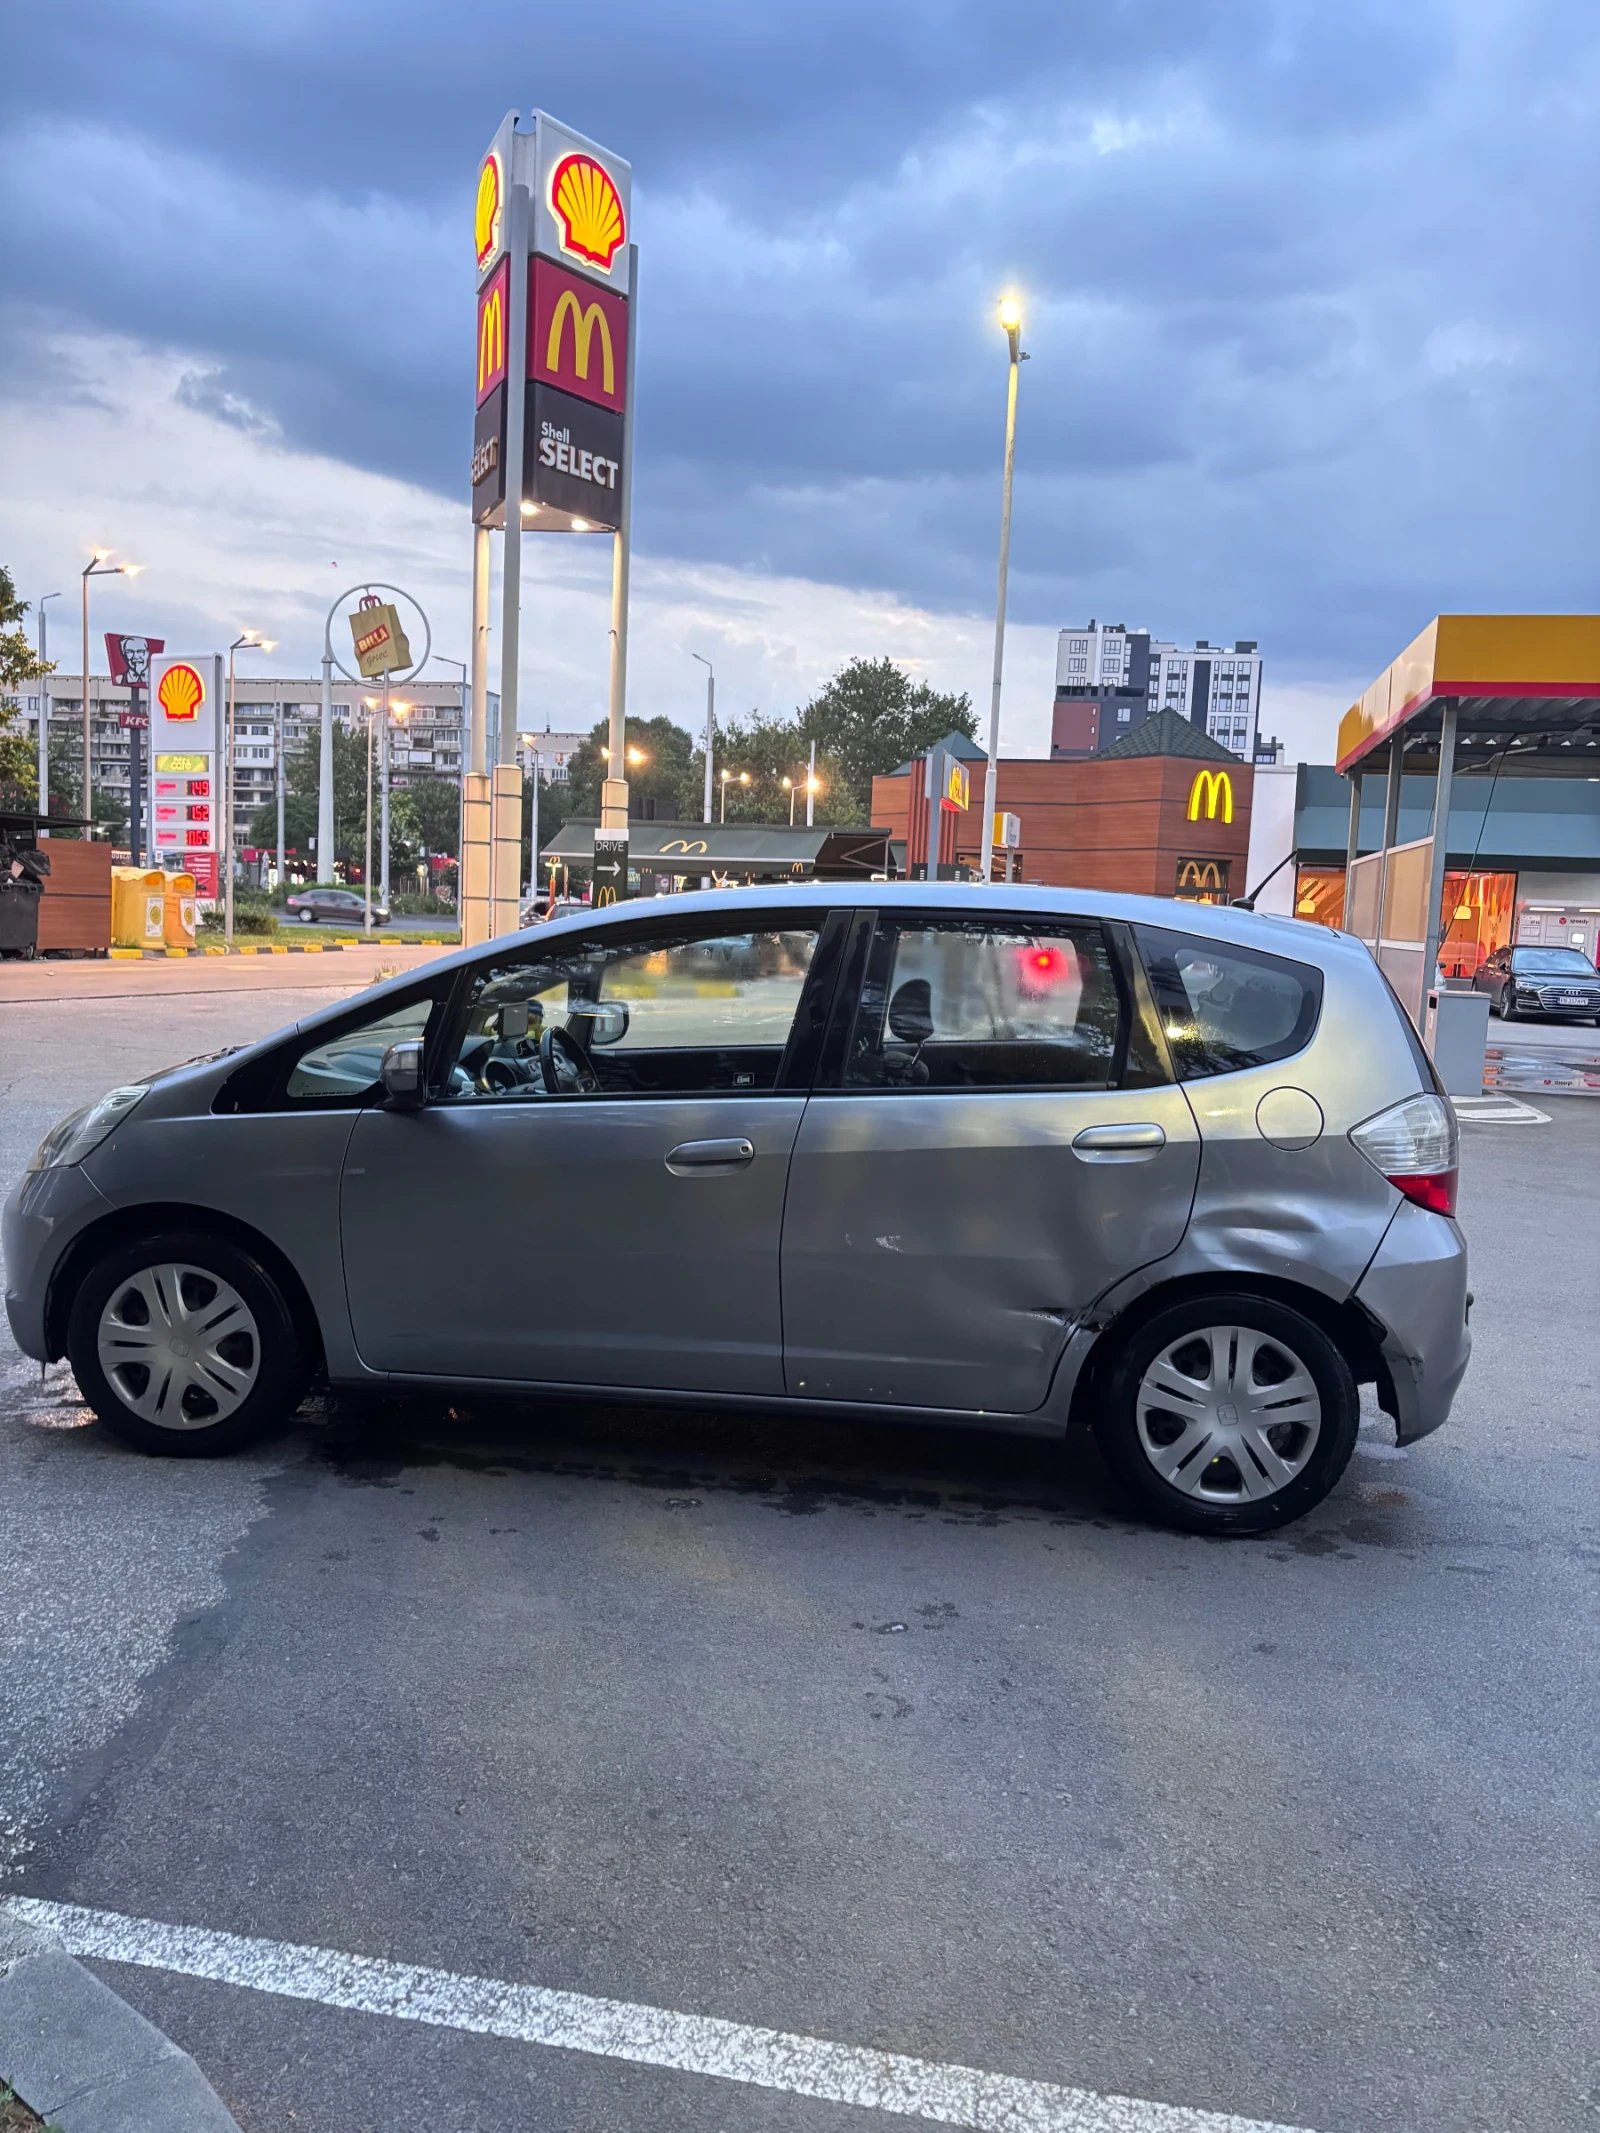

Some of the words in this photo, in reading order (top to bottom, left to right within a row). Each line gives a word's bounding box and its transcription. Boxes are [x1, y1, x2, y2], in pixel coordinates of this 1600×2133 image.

[541, 421, 570, 444] Shell
[471, 436, 499, 487] SELECT
[538, 437, 619, 489] SELECT
[358, 628, 388, 652] BILLA
[125, 715, 149, 726] KFC
[595, 841, 624, 852] DRIVE
